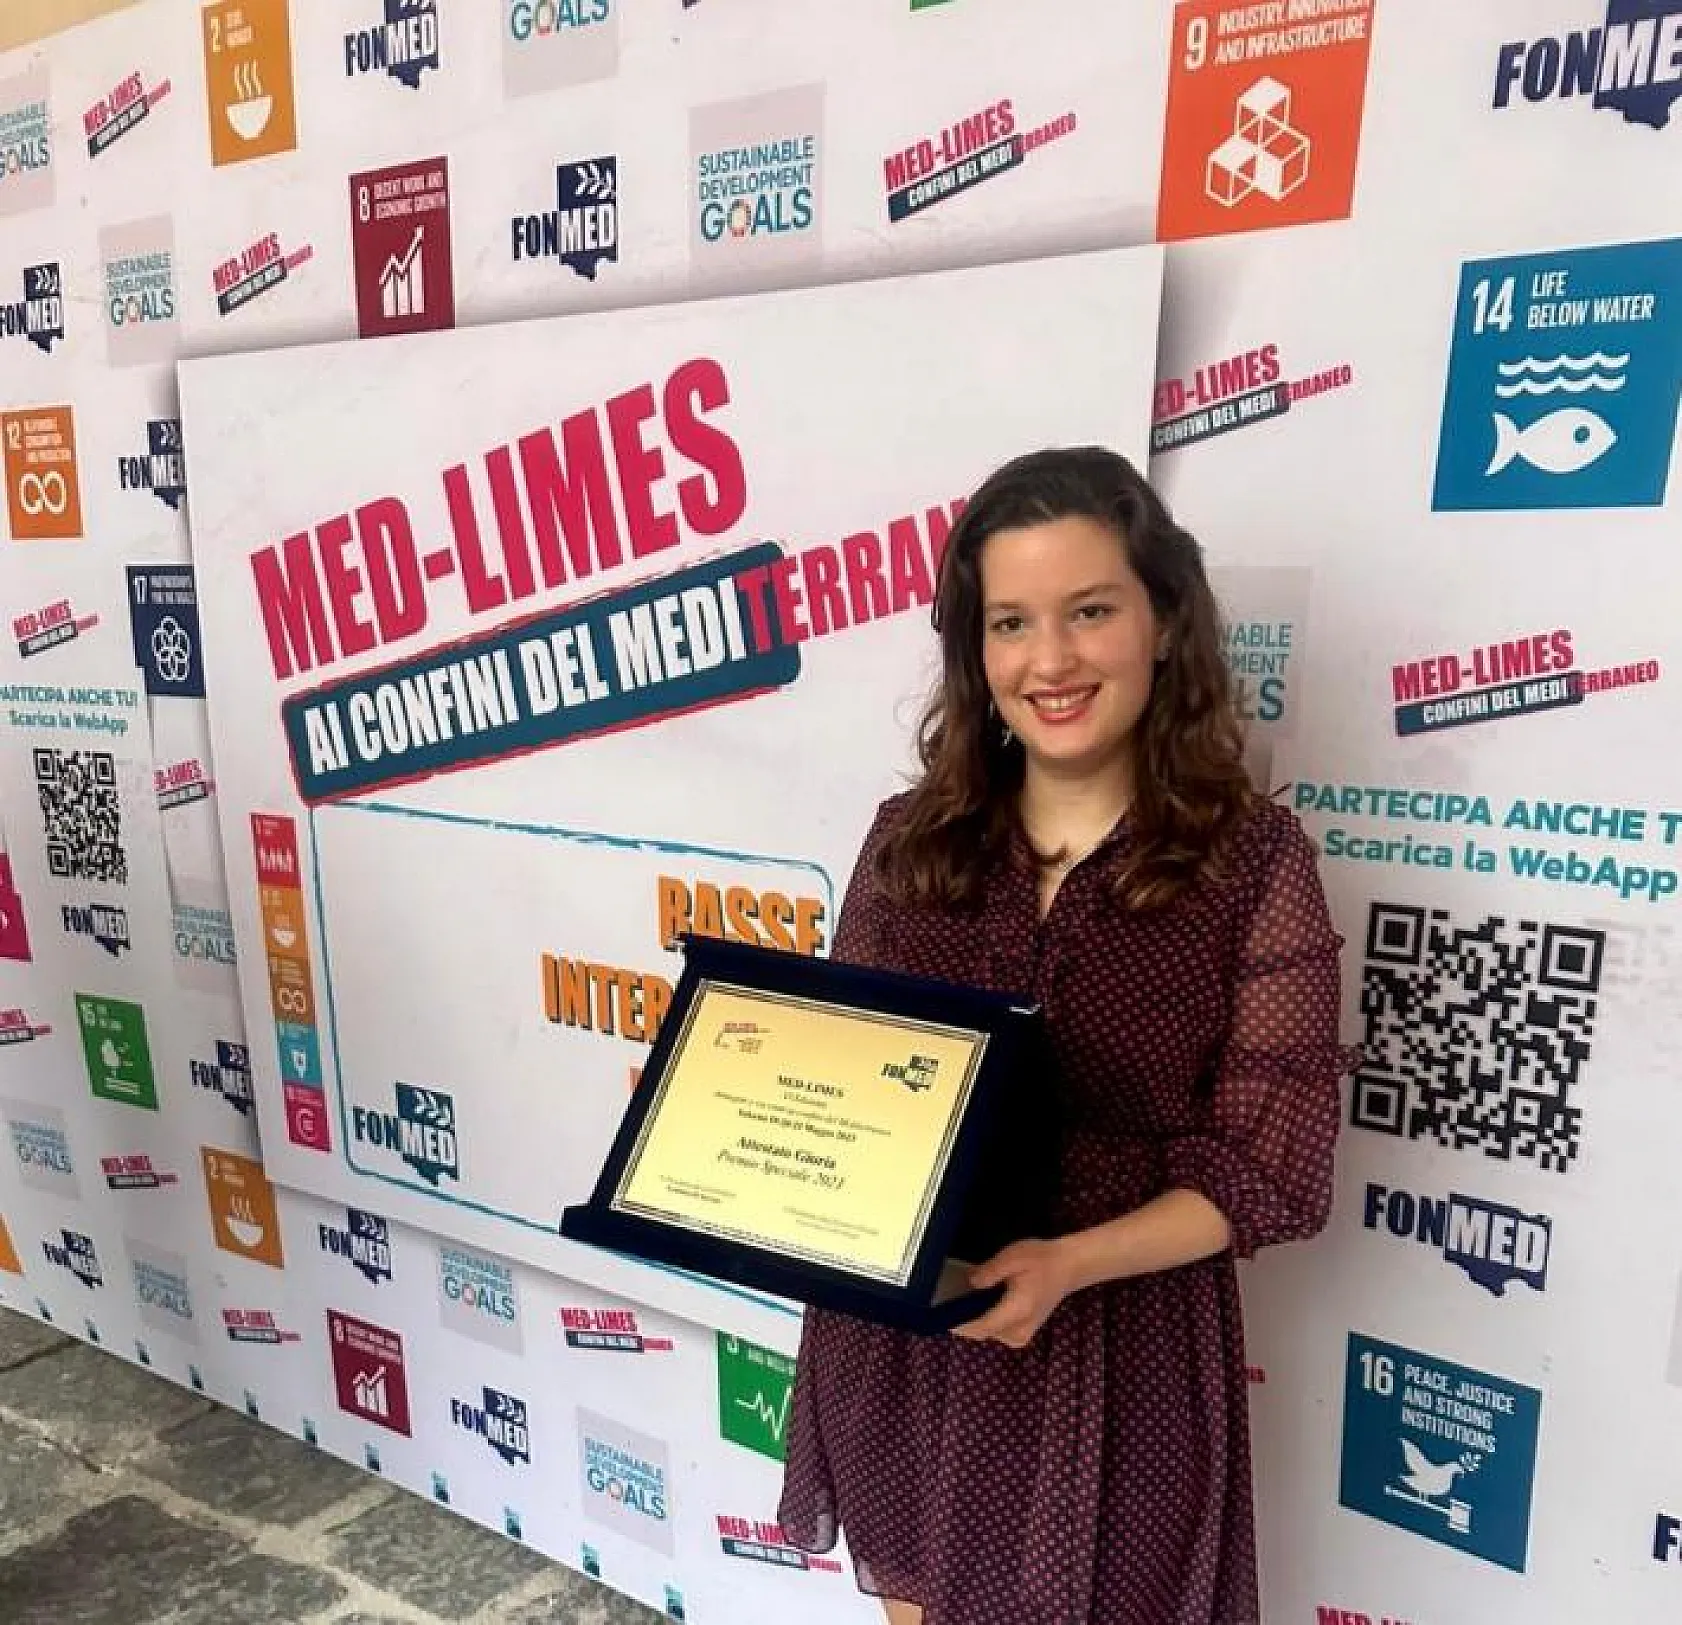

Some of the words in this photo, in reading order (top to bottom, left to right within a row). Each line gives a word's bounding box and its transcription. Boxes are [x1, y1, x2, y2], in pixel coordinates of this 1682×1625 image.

[210, 15, 222, 54] 2
[344, 12, 436, 78] FONMED
[1185, 17, 1208, 70] 9
[1492, 12, 1682, 110] FONME
[700, 135, 815, 175] SUSTAINABLE
[884, 99, 1014, 192] MED-LIMES
[359, 186, 371, 223] 8
[700, 163, 815, 201] DEVELOPMENT
[512, 204, 615, 262] FONMED
[701, 187, 812, 242] GOALS
[110, 289, 174, 327] GOALS
[1472, 276, 1517, 335] 14
[1532, 270, 1569, 298] LIFE
[1527, 299, 1589, 330] BELOW
[1593, 294, 1655, 324] WATER
[1154, 344, 1280, 419] ED-LIMES
[249, 357, 748, 681] MED-LIMES
[1392, 630, 1574, 702] MED-LIMES
[302, 702, 351, 777] AI
[349, 645, 520, 762] CONFINI
[518, 621, 610, 718] DEL
[1423, 695, 1489, 725] CONFINI
[1491, 686, 1522, 711] DEL
[1295, 782, 1492, 825] PARTECIPA
[1503, 800, 1645, 841] ANCHE
[1324, 829, 1453, 869] Scarica
[1463, 840, 1497, 873] la
[1509, 846, 1678, 901] WebApp
[353, 1106, 456, 1165] FONMED
[318, 1223, 390, 1272] FONMED
[1363, 1181, 1547, 1273] FONMED
[443, 1276, 515, 1321] GOALS
[1360, 1352, 1396, 1396] 16
[1455, 1381, 1515, 1414] JUSTICE
[450, 1398, 529, 1453] FONMED
[1401, 1406, 1496, 1453] INSTITUTIONS
[1402, 1386, 1432, 1410] AND
[1434, 1396, 1493, 1430] STRONG
[586, 1467, 666, 1521] GOALS
